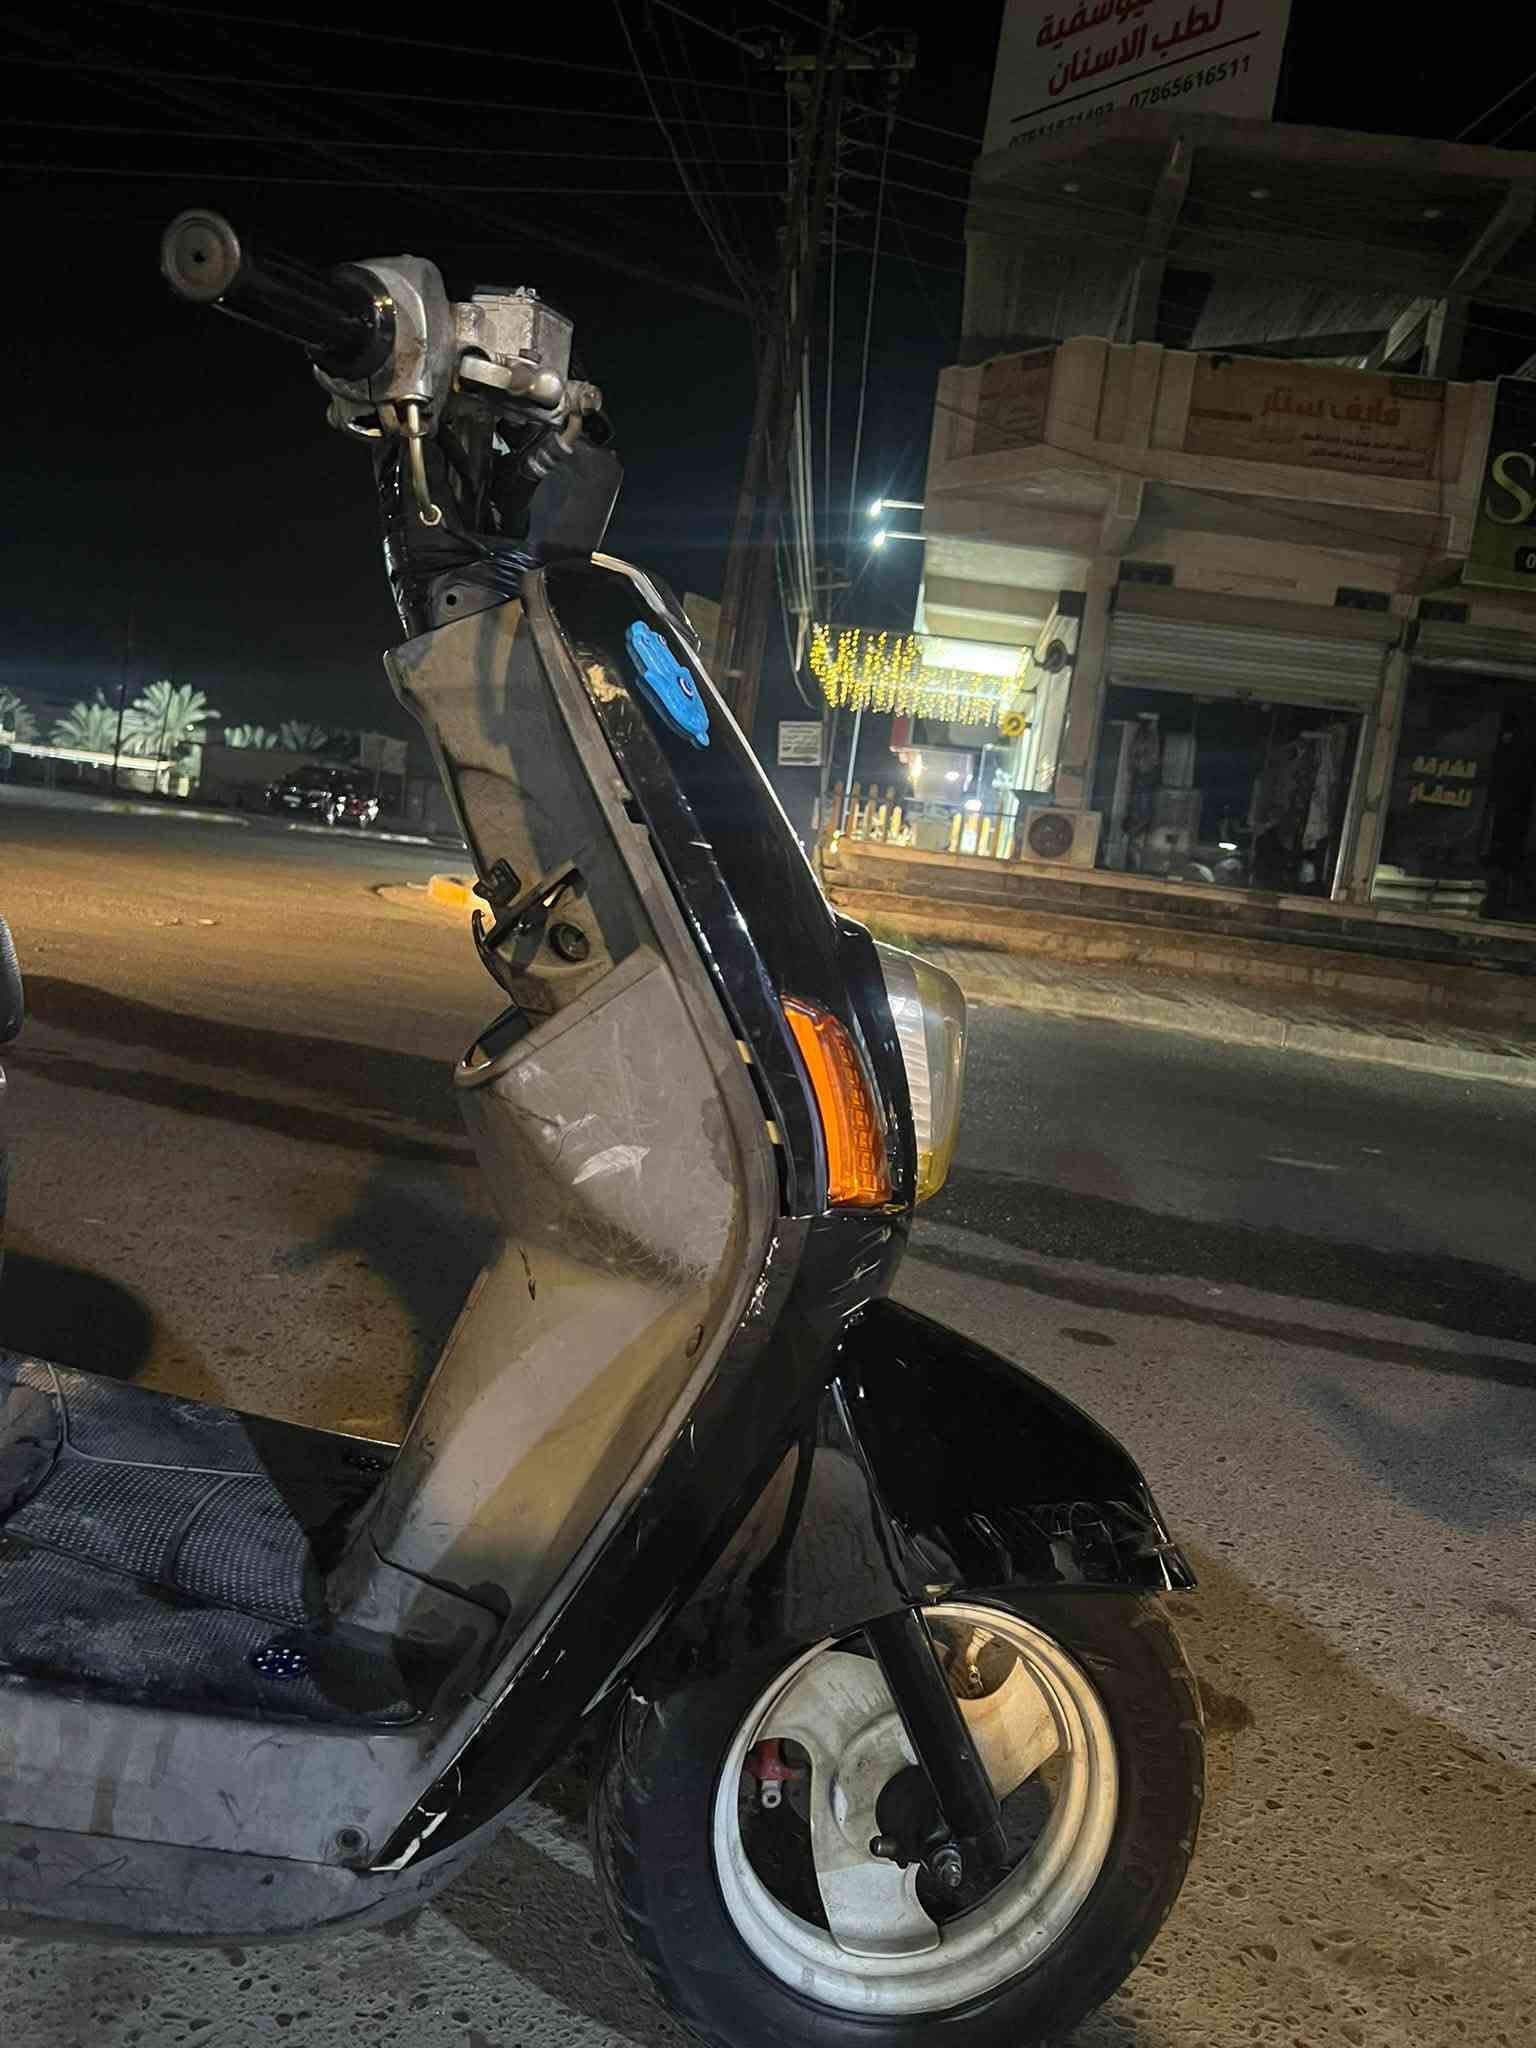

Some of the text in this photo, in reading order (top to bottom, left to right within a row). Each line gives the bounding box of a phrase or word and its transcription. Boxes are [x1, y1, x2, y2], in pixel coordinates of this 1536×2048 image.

[1036, 0, 1154, 50] يوسفية
[1047, 0, 1225, 96] لطب الاسنان
[1486, 450, 1536, 524] S
